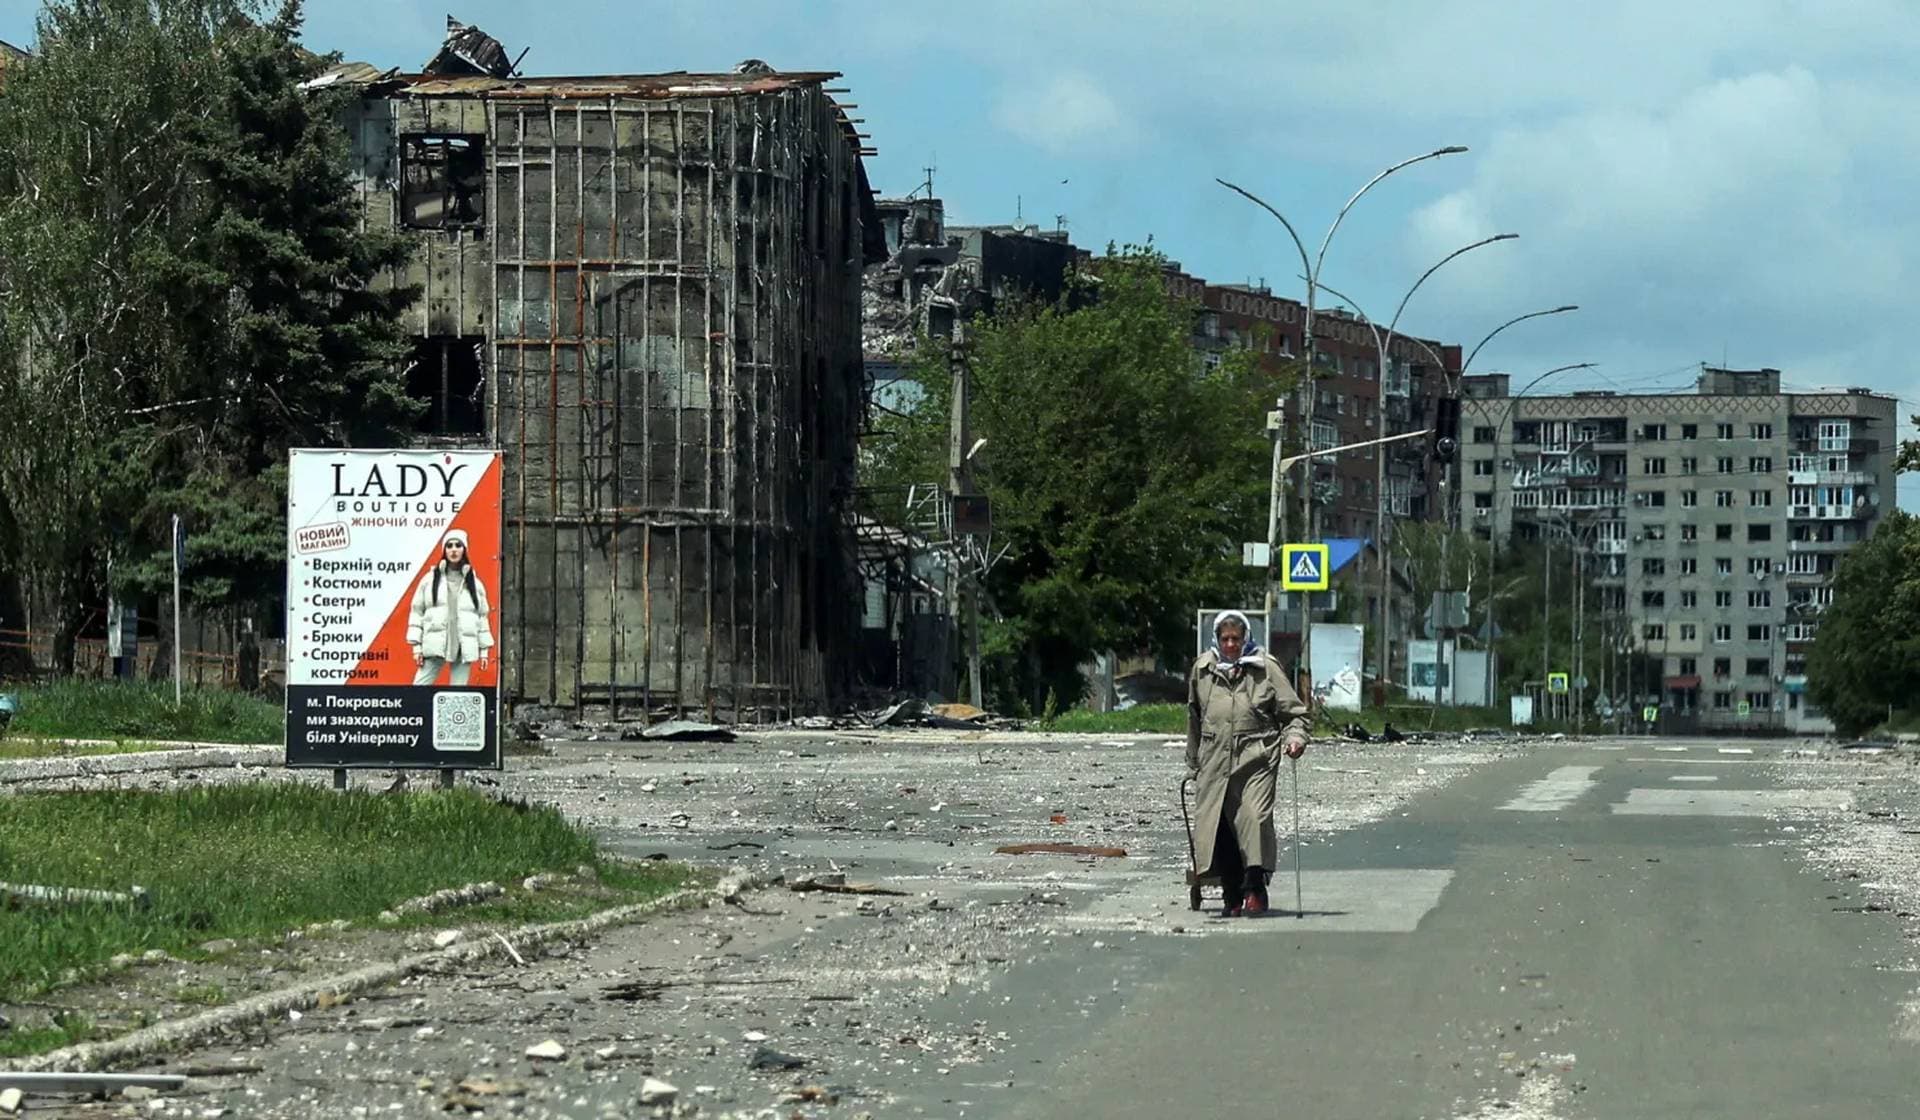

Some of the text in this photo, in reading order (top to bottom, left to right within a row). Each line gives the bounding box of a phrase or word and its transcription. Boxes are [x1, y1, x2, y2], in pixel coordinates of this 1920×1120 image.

[331, 460, 469, 497] LADY
[336, 501, 461, 513] BOUTIQUE
[351, 516, 447, 529] ЖІНОЧІЙ ОДЯГ
[299, 525, 345, 543] НОВИЙ
[300, 538, 347, 551] МАГАЗИН
[312, 558, 411, 574] Верхній одяг
[312, 576, 382, 589] Костюми
[312, 594, 366, 610] Светри
[311, 612, 352, 625] Сукні
[311, 630, 363, 645] Брюки
[310, 648, 389, 665] Спортивні
[310, 667, 379, 679] костюми
[306, 695, 402, 711] м. Покровськ
[306, 715, 424, 728] ми знаходимося
[306, 731, 420, 747] біля Універмагу
